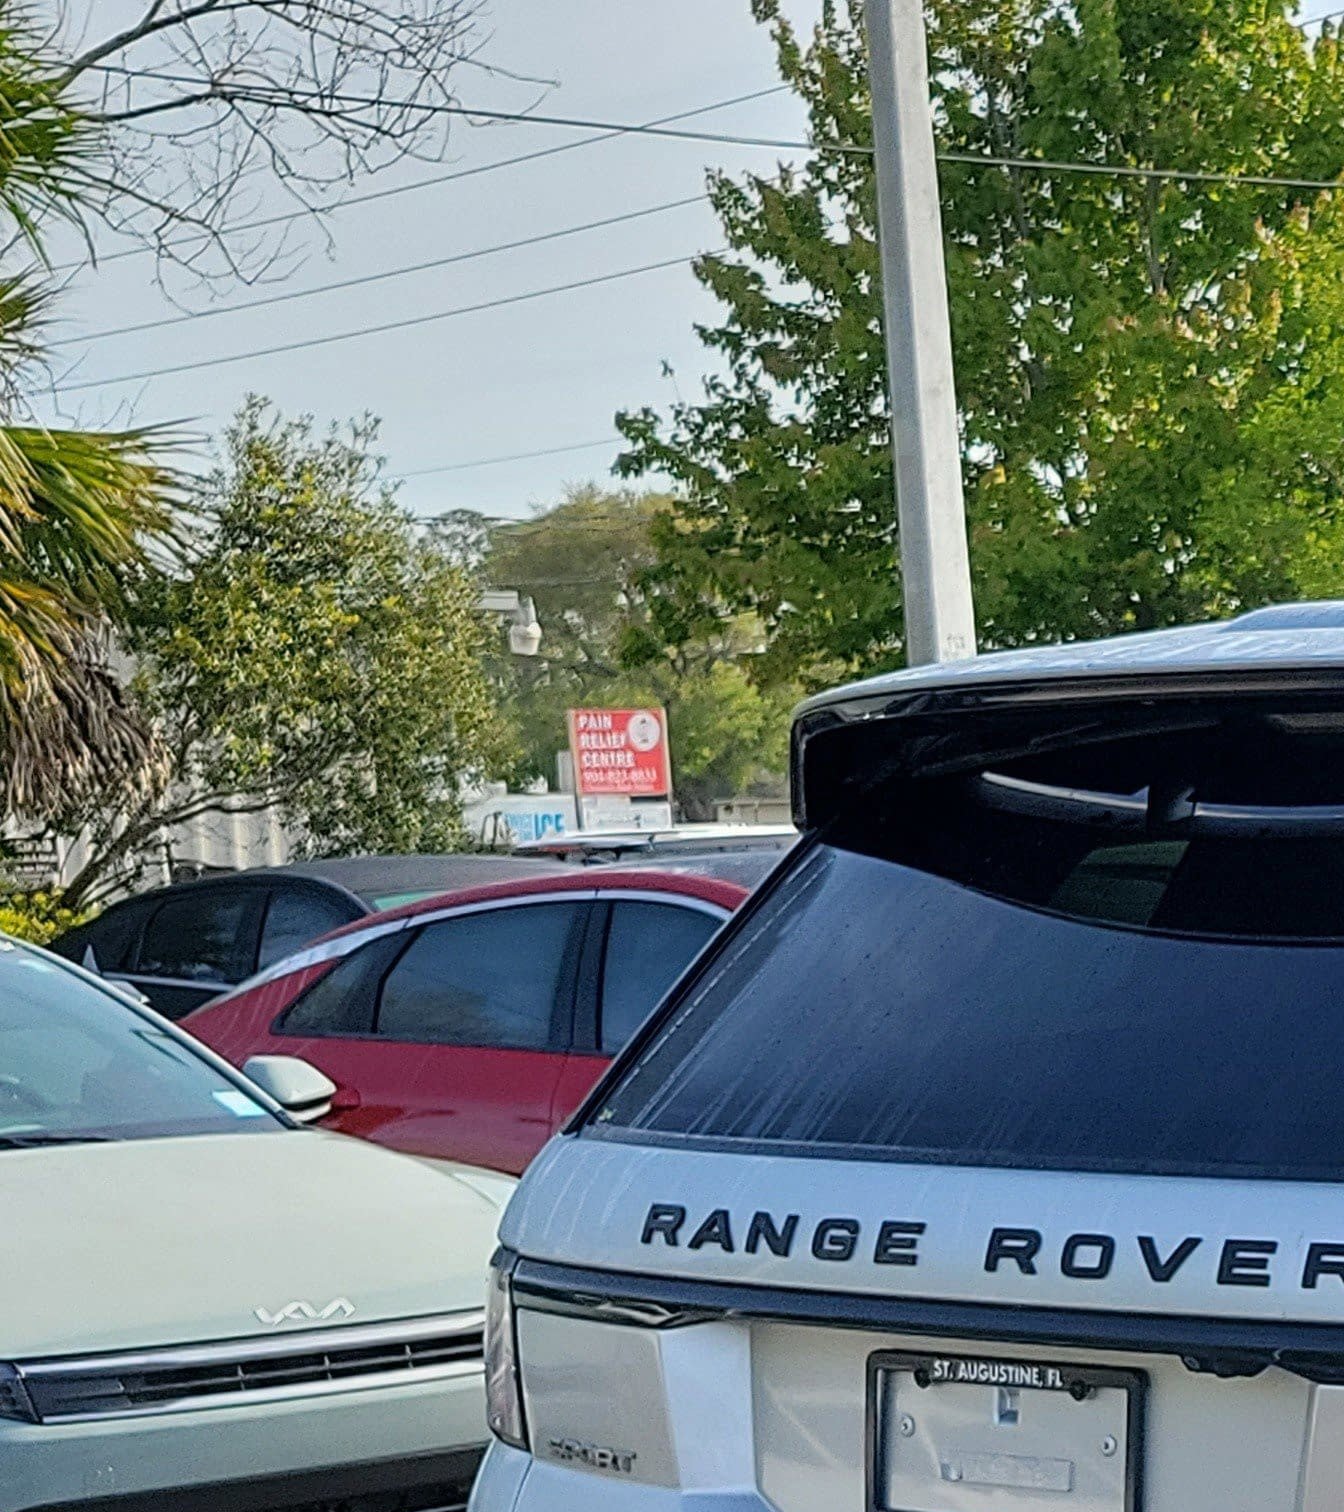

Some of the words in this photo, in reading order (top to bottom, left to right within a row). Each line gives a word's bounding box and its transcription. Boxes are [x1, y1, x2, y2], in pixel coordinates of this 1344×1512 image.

[579, 714, 612, 729] PAIN
[580, 732, 626, 748] RELIEF
[582, 751, 636, 768] CENTRE
[640, 1203, 927, 1266] RANGE
[933, 1361, 954, 1380] ST.
[958, 1362, 1044, 1388] AUGUSTINE,
[1048, 1368, 1064, 1387] FL
